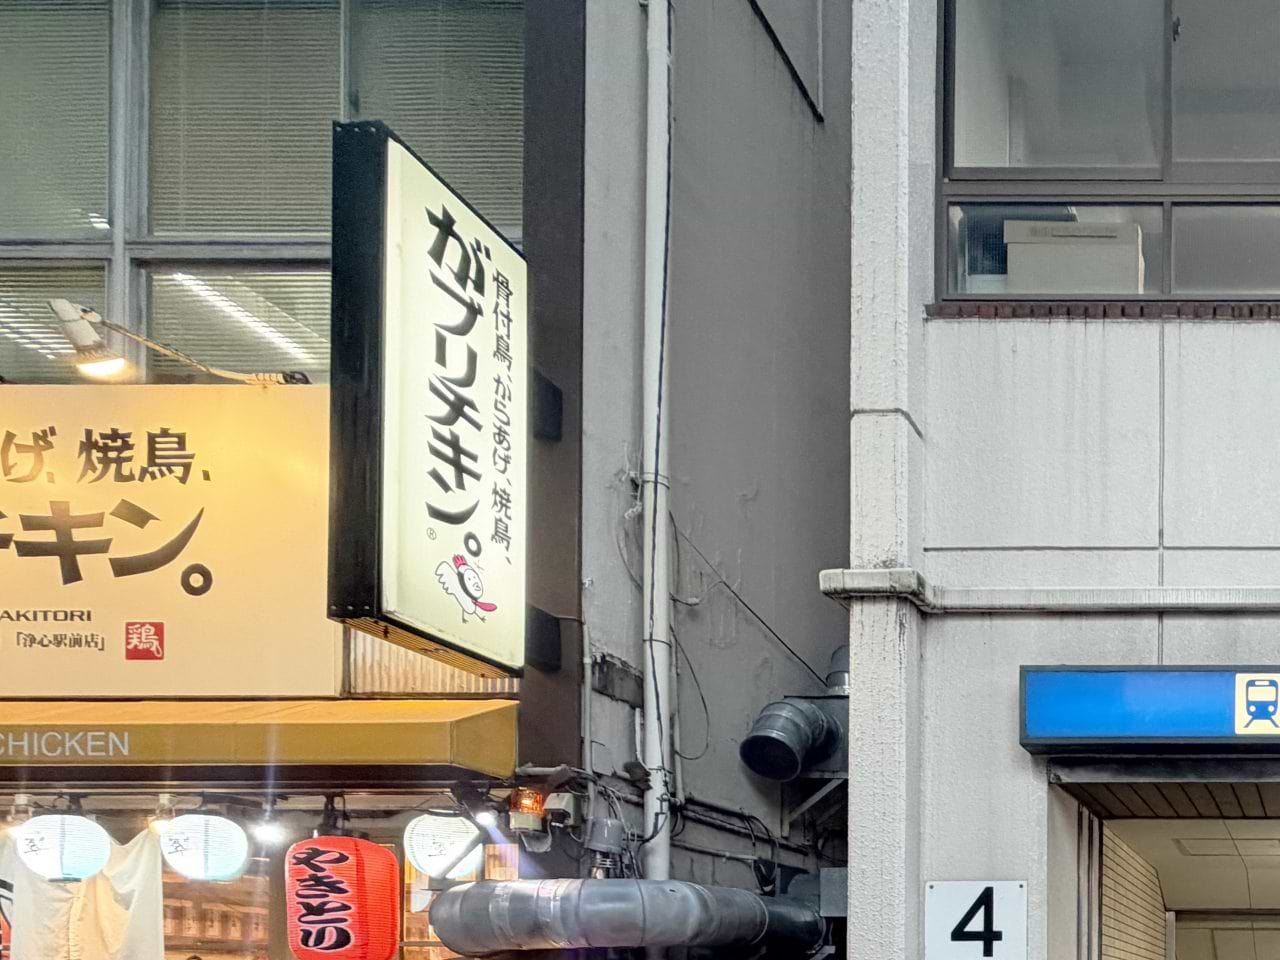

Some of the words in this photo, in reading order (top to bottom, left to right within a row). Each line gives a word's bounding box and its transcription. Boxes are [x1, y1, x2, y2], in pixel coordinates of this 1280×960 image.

[0, 498, 213, 596] キン。
[0, 731, 130, 757] HICKEN
[291, 846, 353, 952] やきとり
[951, 886, 1003, 957] 4
